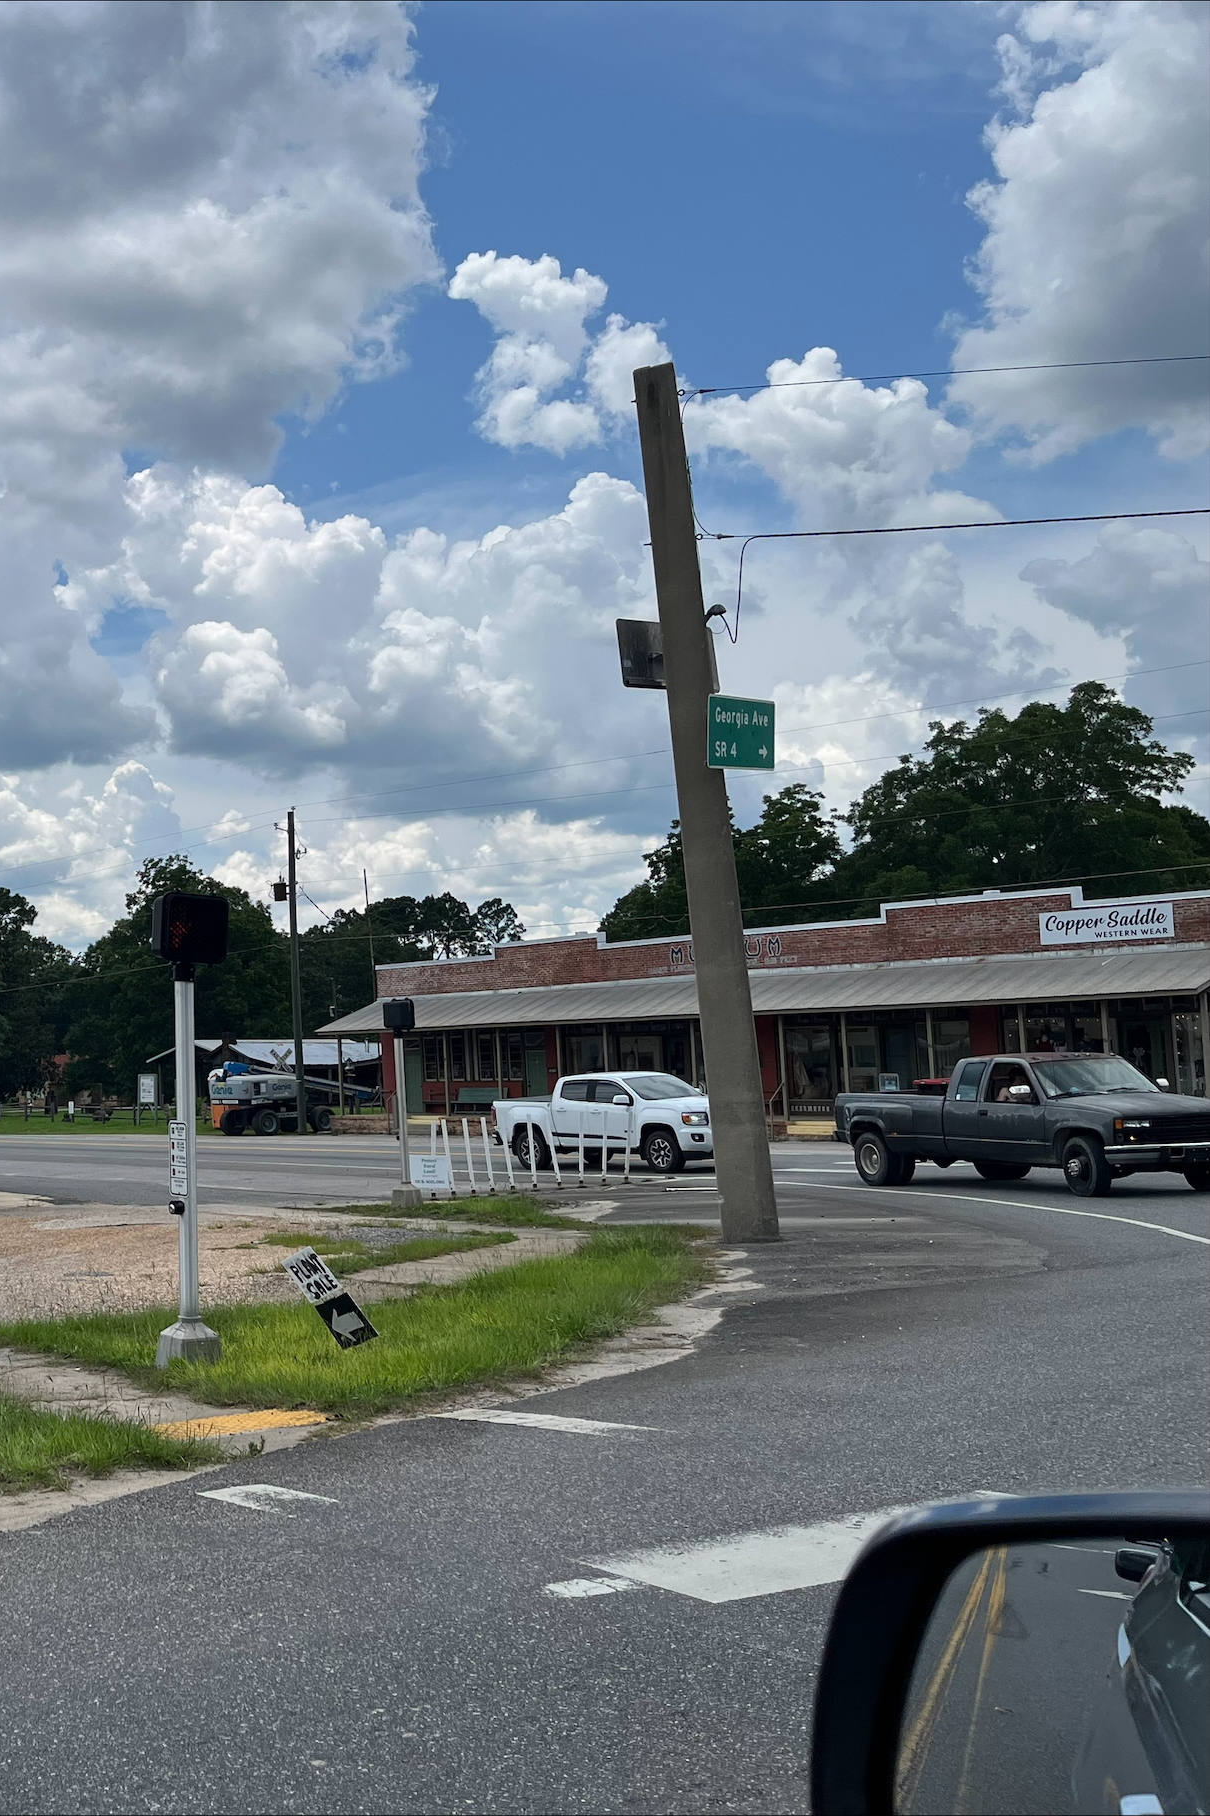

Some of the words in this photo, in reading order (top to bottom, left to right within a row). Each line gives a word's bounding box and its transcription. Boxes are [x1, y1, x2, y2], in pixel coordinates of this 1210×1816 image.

[715, 706, 749, 729] Georgia
[752, 710, 769, 727] Ave
[715, 741, 727, 758] SR
[730, 742, 737, 758] 4
[1045, 915, 1105, 936] Copper
[1107, 907, 1168, 928] Saddle
[1094, 929, 1137, 939] WESTERN
[1140, 927, 1169, 936] WEAR
[670, 935, 782, 965] MUM
[211, 1084, 234, 1096] Genie
[272, 1082, 292, 1092] Genie
[290, 1253, 326, 1284] PLANT
[306, 1274, 338, 1300] SALE
